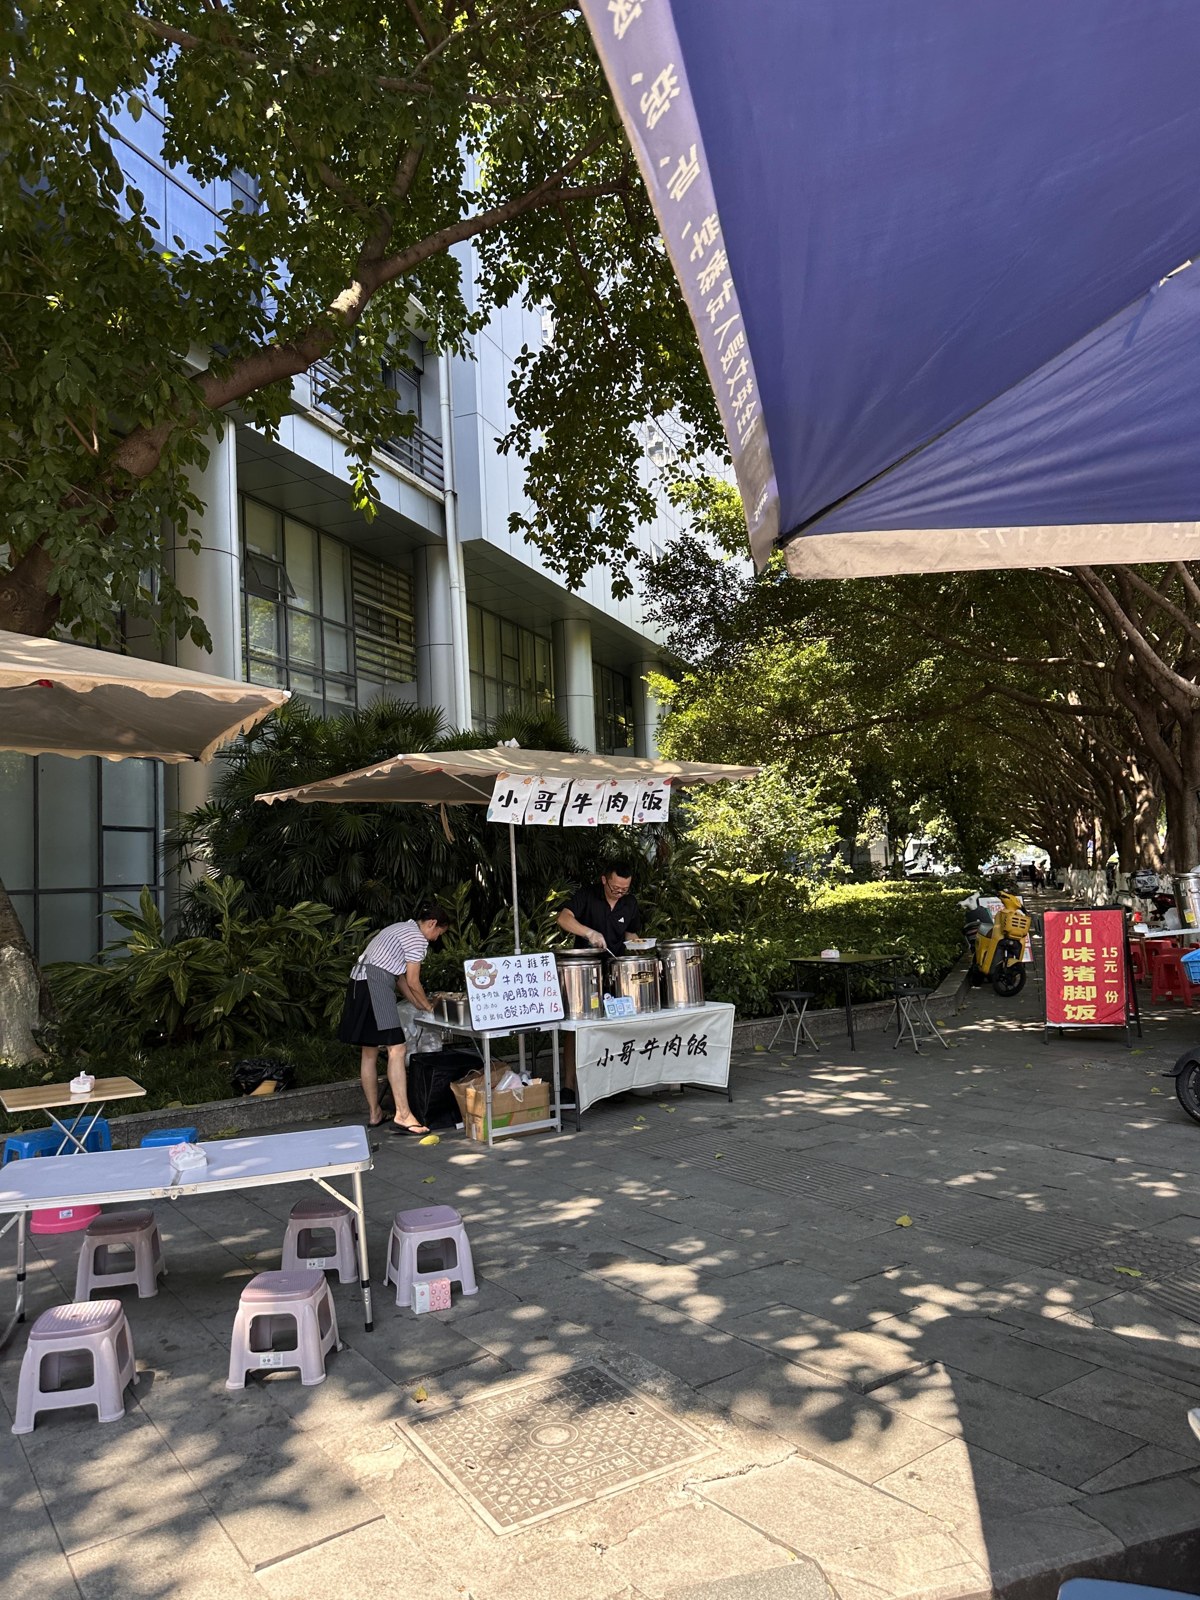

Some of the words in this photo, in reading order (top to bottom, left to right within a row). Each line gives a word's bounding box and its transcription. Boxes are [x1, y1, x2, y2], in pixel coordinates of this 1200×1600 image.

[498, 789, 664, 814] 小哥牛肉饭
[1065, 913, 1092, 926] 小王
[502, 955, 550, 969] 今日推荐
[502, 971, 538, 985] 牛肉饭
[1061, 928, 1097, 1020] 川味猪脚饭
[596, 1033, 708, 1068] 小哥牛肉饭
